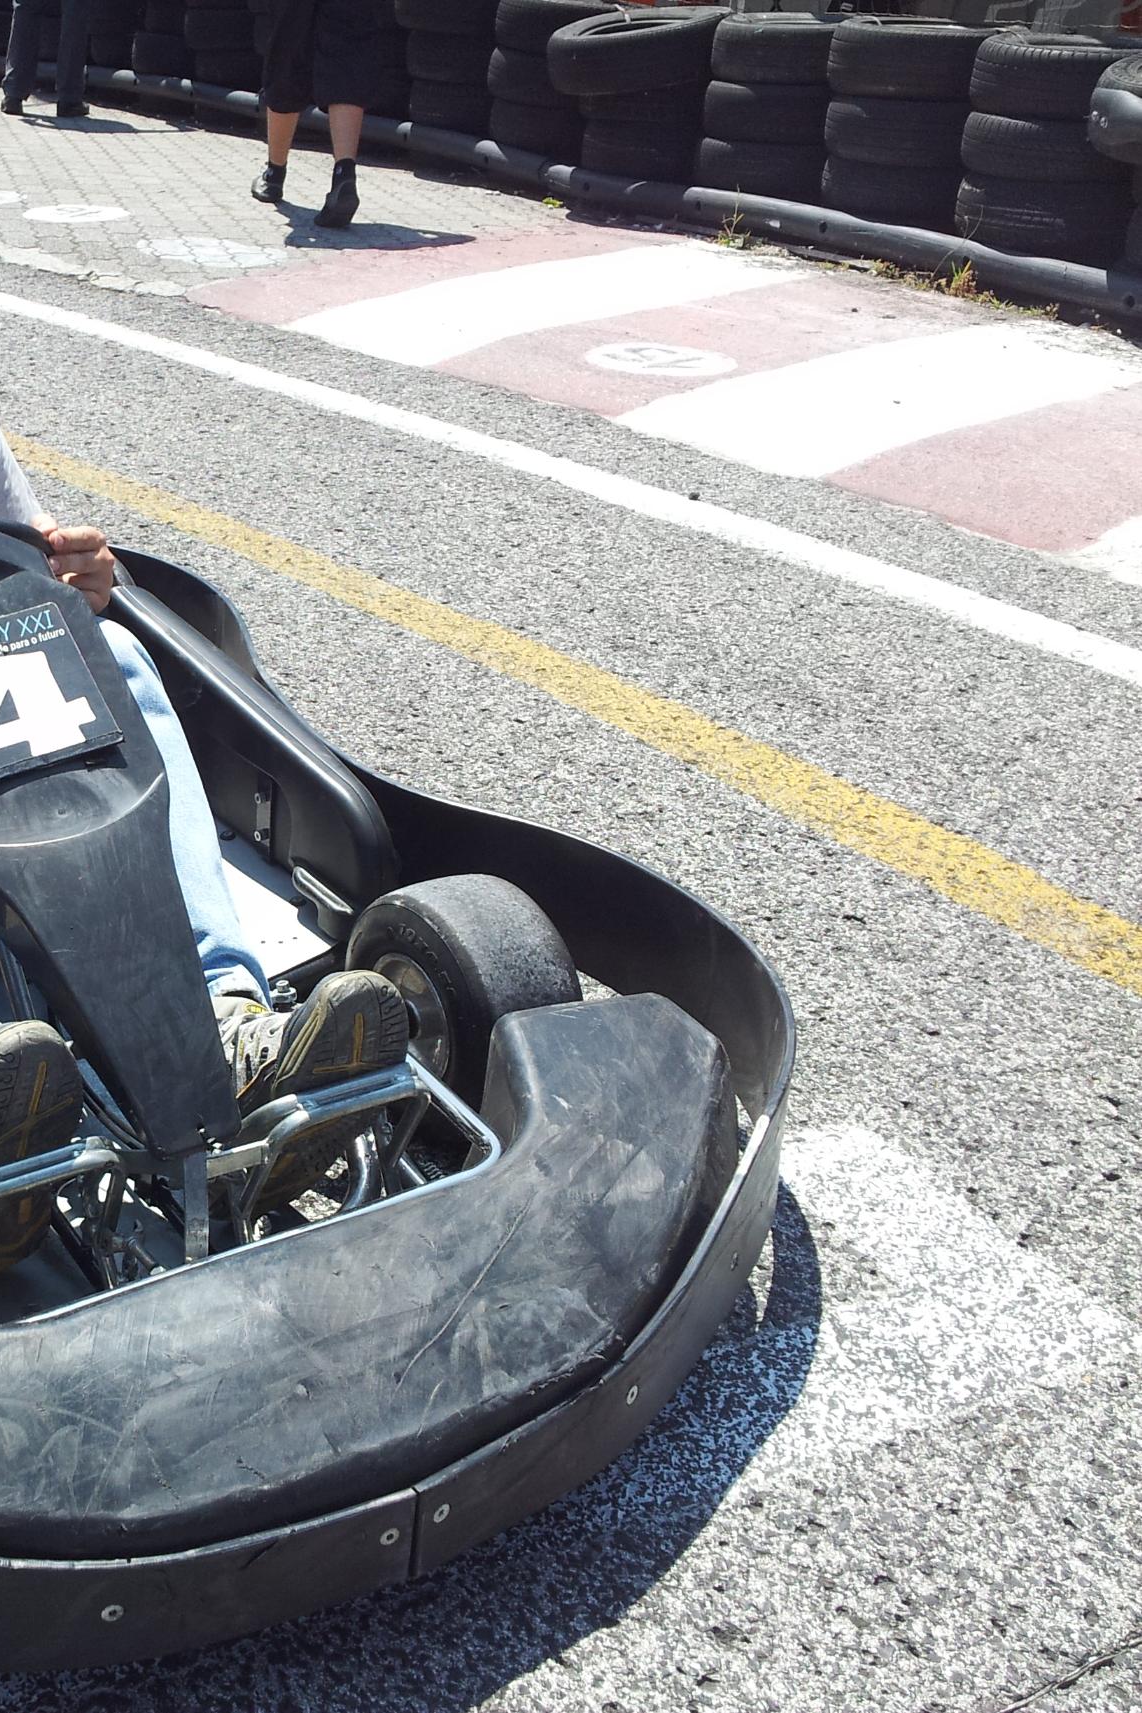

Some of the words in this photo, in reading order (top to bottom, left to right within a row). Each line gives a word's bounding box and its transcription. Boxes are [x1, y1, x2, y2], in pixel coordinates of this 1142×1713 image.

[17, 610, 54, 637] XXI
[10, 638, 30, 651] para
[31, 637, 38, 645] o
[38, 628, 66, 643] futuro
